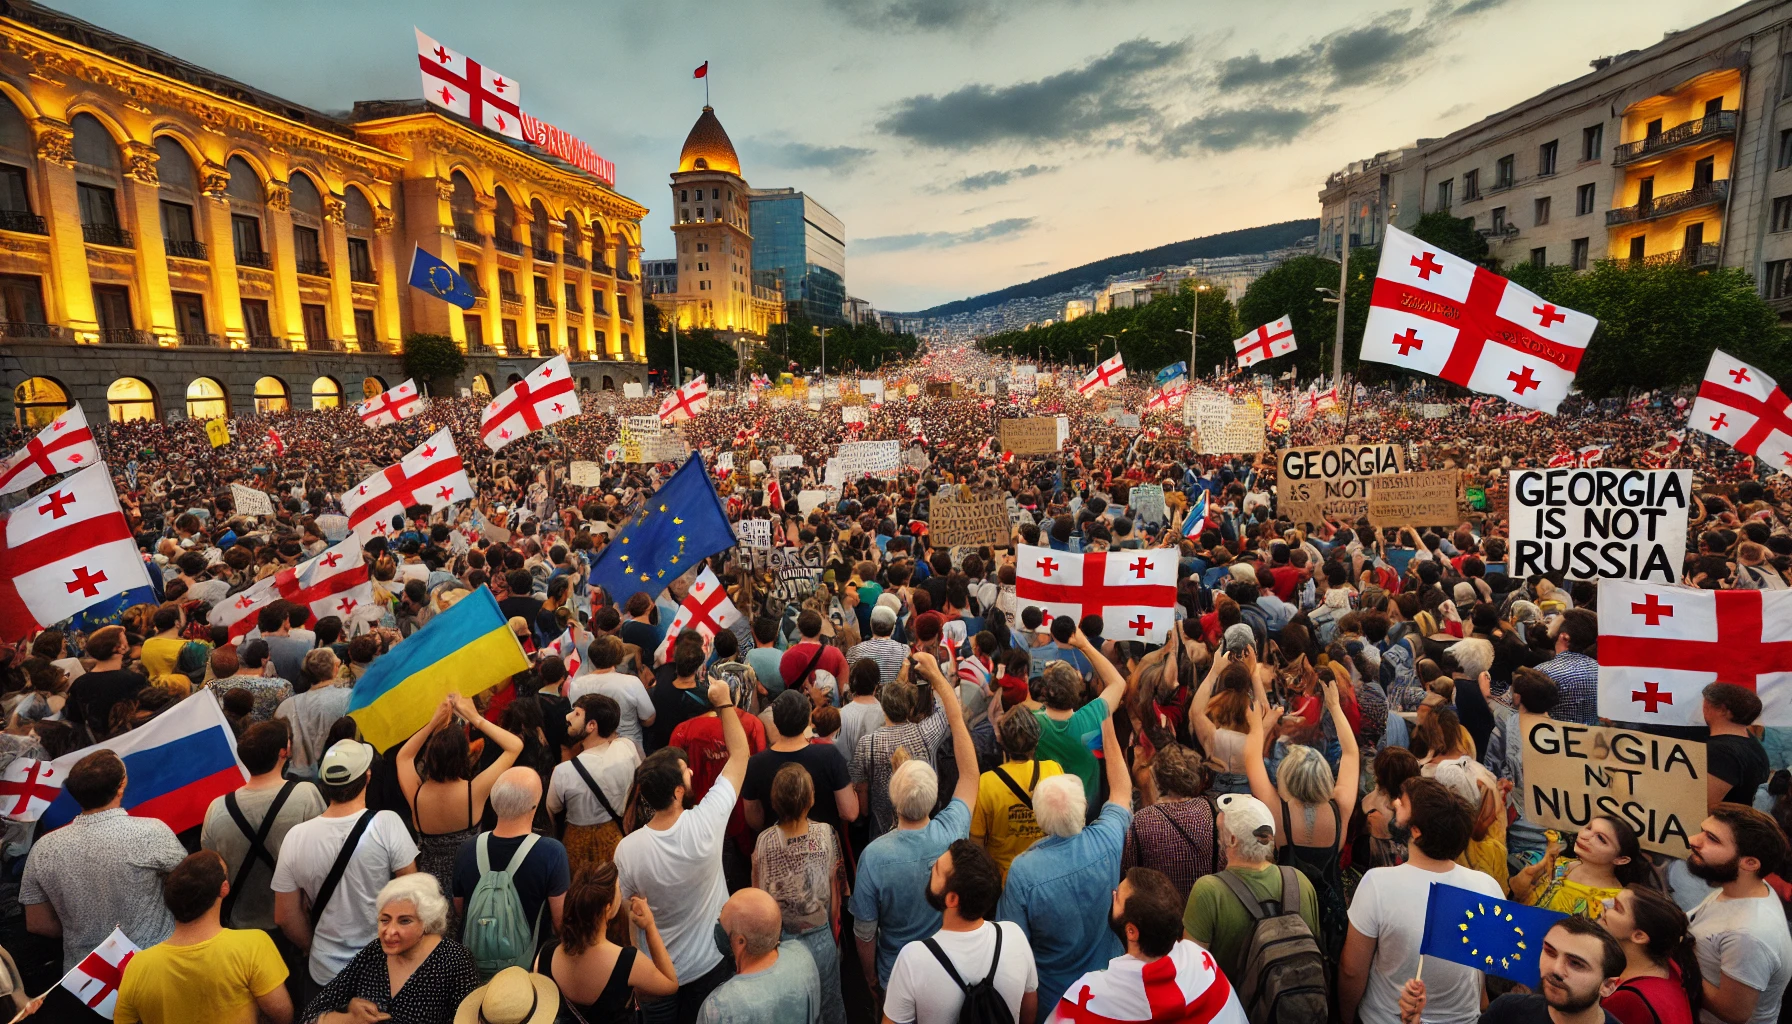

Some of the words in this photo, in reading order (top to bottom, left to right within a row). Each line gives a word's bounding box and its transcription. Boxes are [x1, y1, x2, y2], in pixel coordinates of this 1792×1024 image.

[1283, 446, 1399, 480] GEORGIA
[1325, 478, 1371, 499] NOT
[1515, 470, 1686, 508] GEORGIA
[1536, 508, 1566, 539] IS
[1584, 508, 1667, 541] NOT
[1514, 540, 1675, 583] RUSSIA
[1529, 723, 1698, 779] GEGIA
[1533, 785, 1692, 849] NUSSIA
